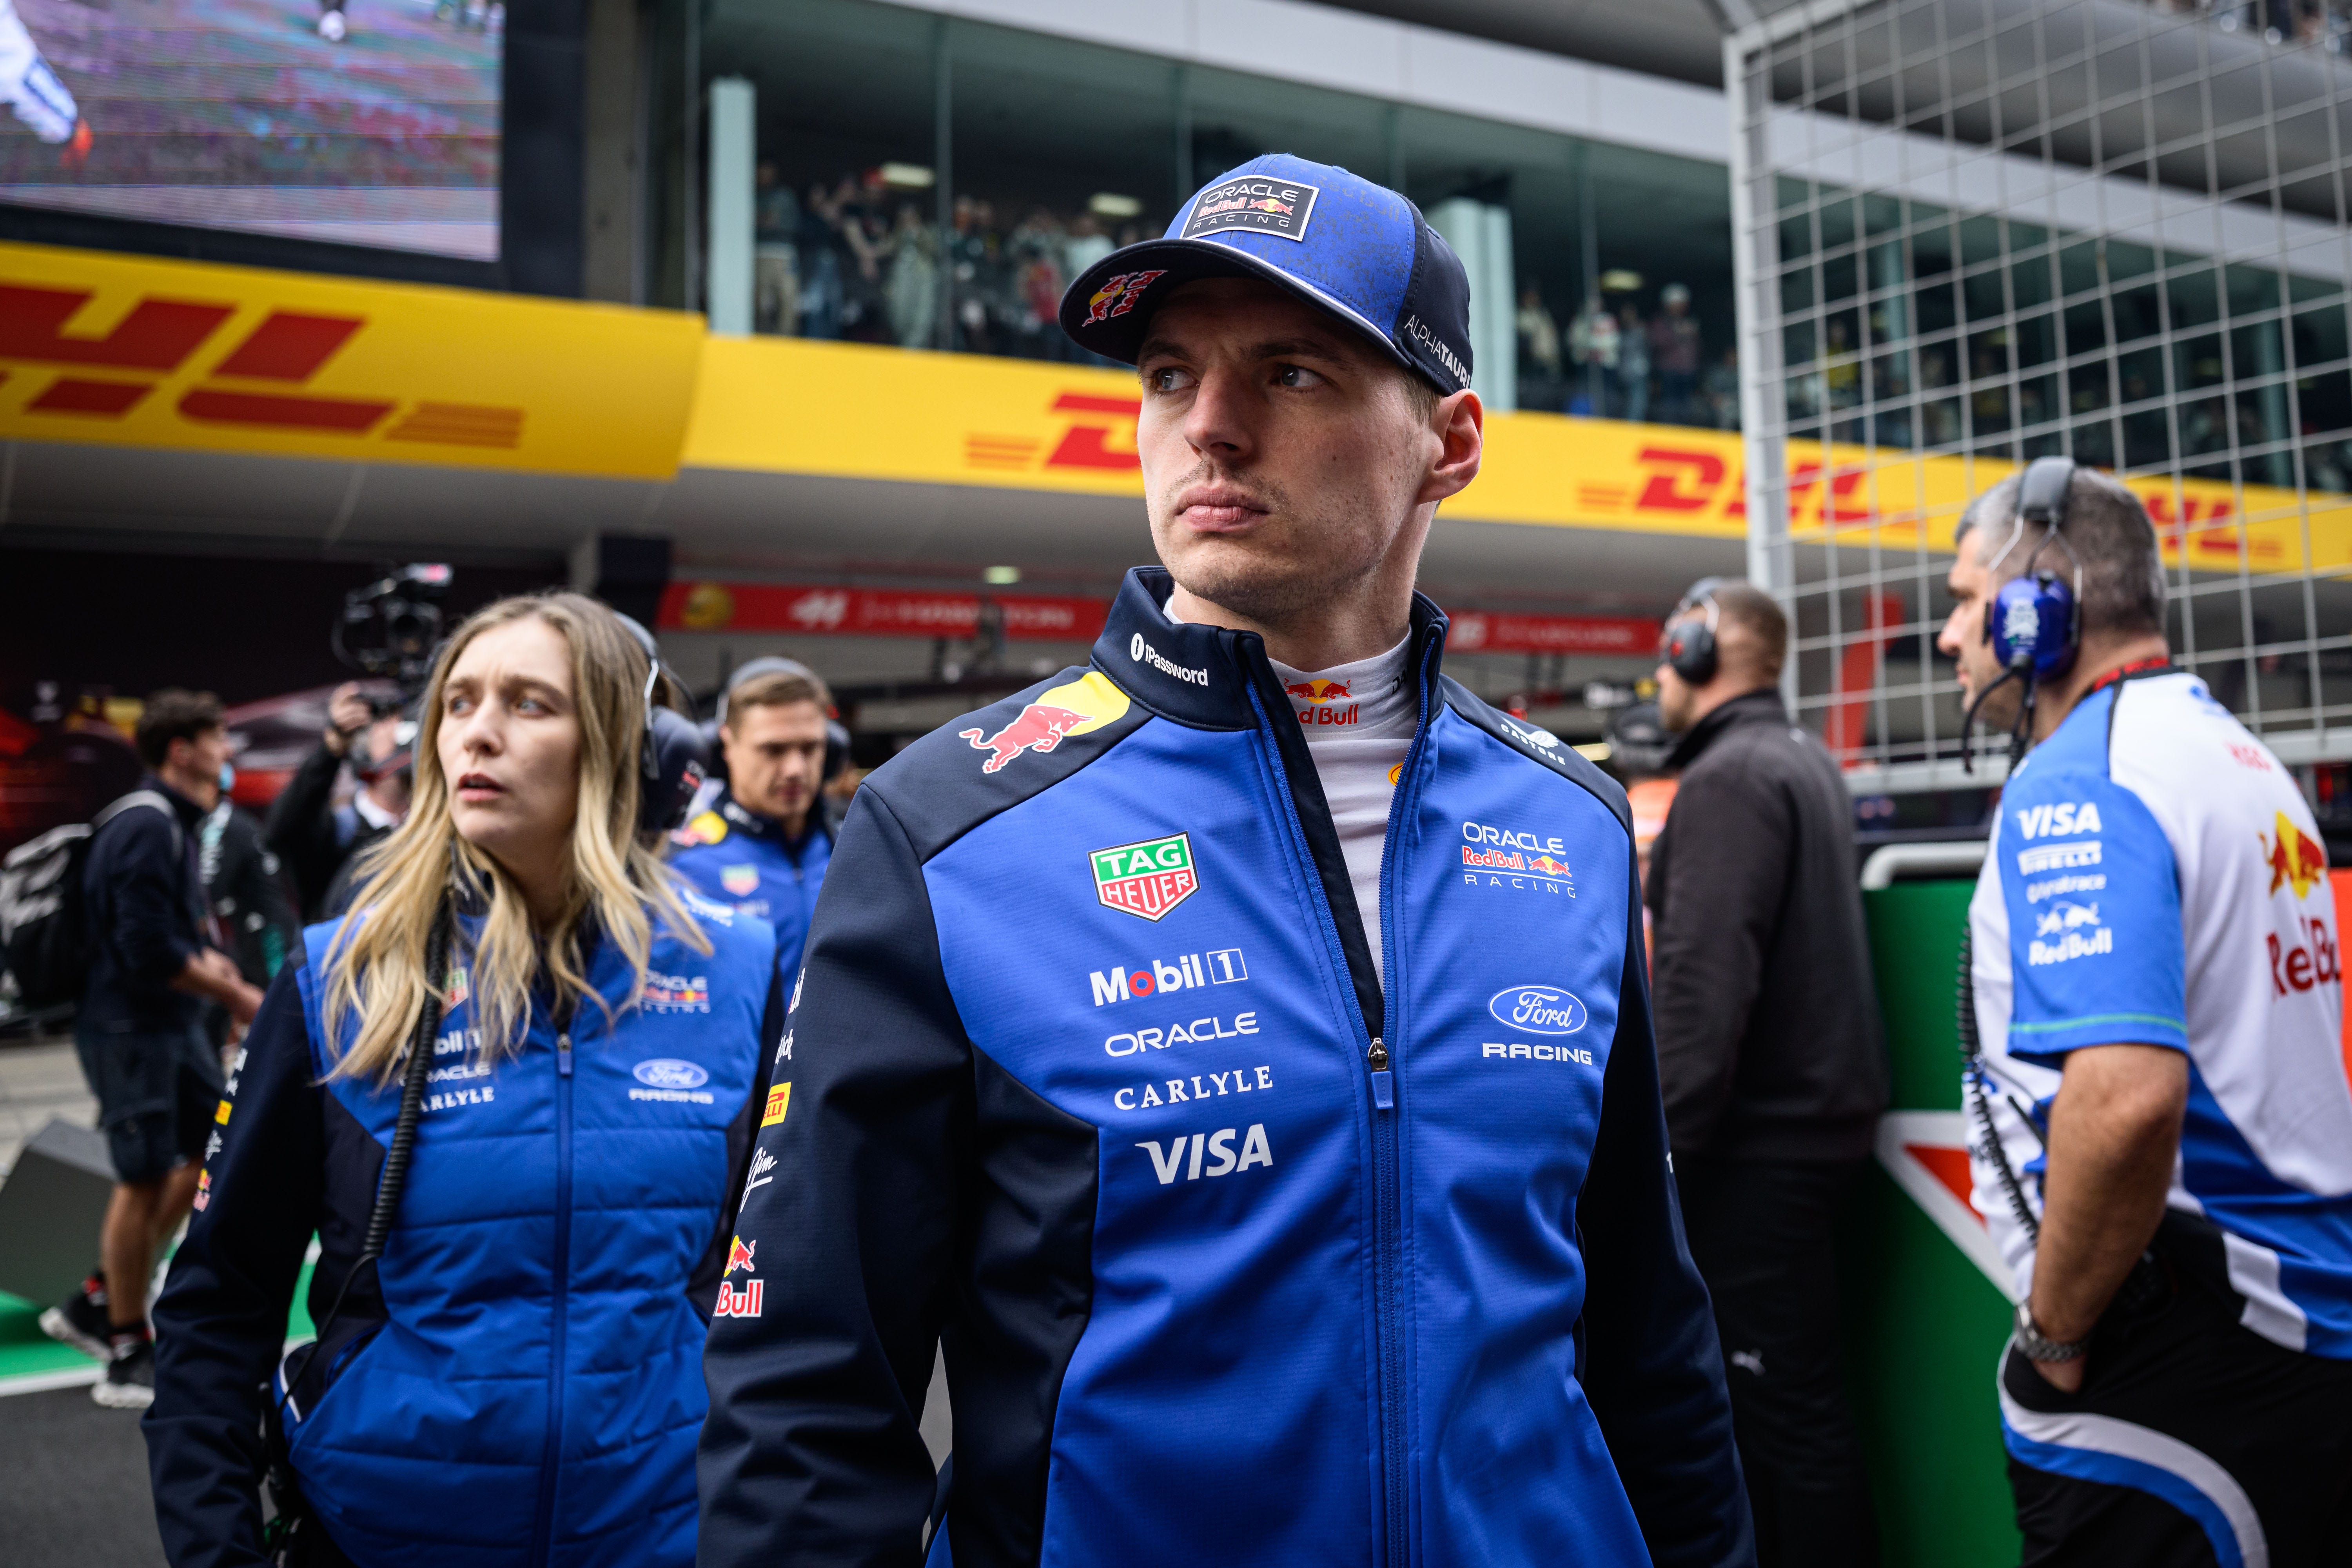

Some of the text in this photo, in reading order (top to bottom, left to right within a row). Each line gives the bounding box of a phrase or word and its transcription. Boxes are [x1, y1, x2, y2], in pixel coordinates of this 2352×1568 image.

[1198, 197, 1247, 218] Red Bull
[1205, 184, 1299, 204] ORACLE
[1192, 214, 1290, 230] RACING
[0, 285, 399, 434] HL
[1404, 315, 1470, 389] ALPHATAURI
[1145, 644, 1209, 686] 1Password
[1318, 704, 1359, 725] Bull
[1501, 724, 1566, 765] CASTORE
[1463, 821, 1566, 855] ORACLE
[2016, 802, 2102, 840] VISA
[1100, 842, 1182, 878] TAG
[1462, 846, 1526, 871] Red Bull
[1104, 873, 1191, 915] HEUER
[1464, 874, 1576, 899] RACING
[2068, 927, 2113, 960] Bull
[2265, 915, 2314, 1001] Re
[1090, 952, 1234, 1007] Mobil 1
[1512, 990, 1572, 1029] Ford
[1105, 1012, 1260, 1057] ORACLE
[1482, 1042, 1592, 1065] RACING
[1114, 1065, 1273, 1111] CARLYLE
[1135, 1123, 1273, 1185] VISA
[716, 1281, 762, 1316] Bull
